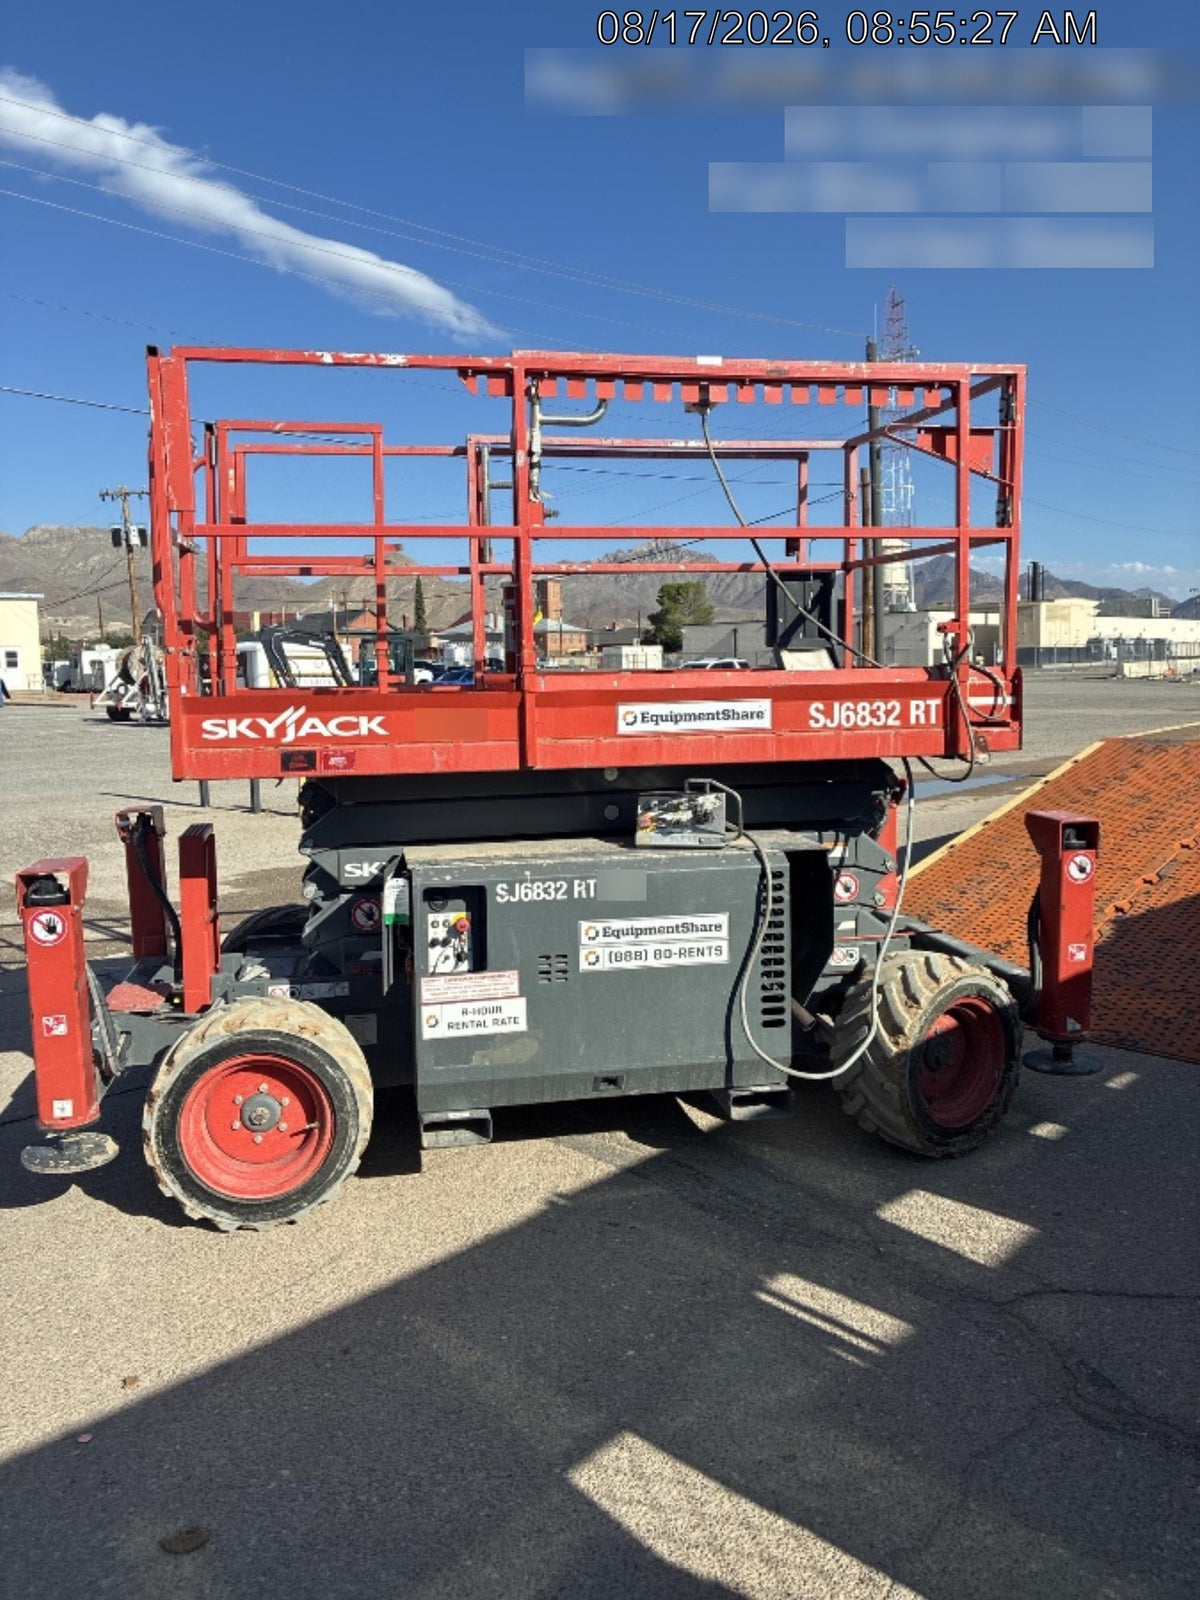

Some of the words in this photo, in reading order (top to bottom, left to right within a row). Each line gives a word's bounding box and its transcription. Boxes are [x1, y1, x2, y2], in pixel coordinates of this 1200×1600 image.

[201, 704, 389, 743] SKYJACK
[640, 706, 766, 726] EquipmentShare
[808, 699, 901, 729] SJ6832
[909, 699, 942, 726] RT
[344, 861, 386, 877] SK
[495, 880, 568, 904] SJ6832
[573, 878, 597, 900] RT
[602, 922, 723, 940] EquipmentShare
[447, 1020, 489, 1031] RENTAL
[492, 1016, 520, 1027] RATE
